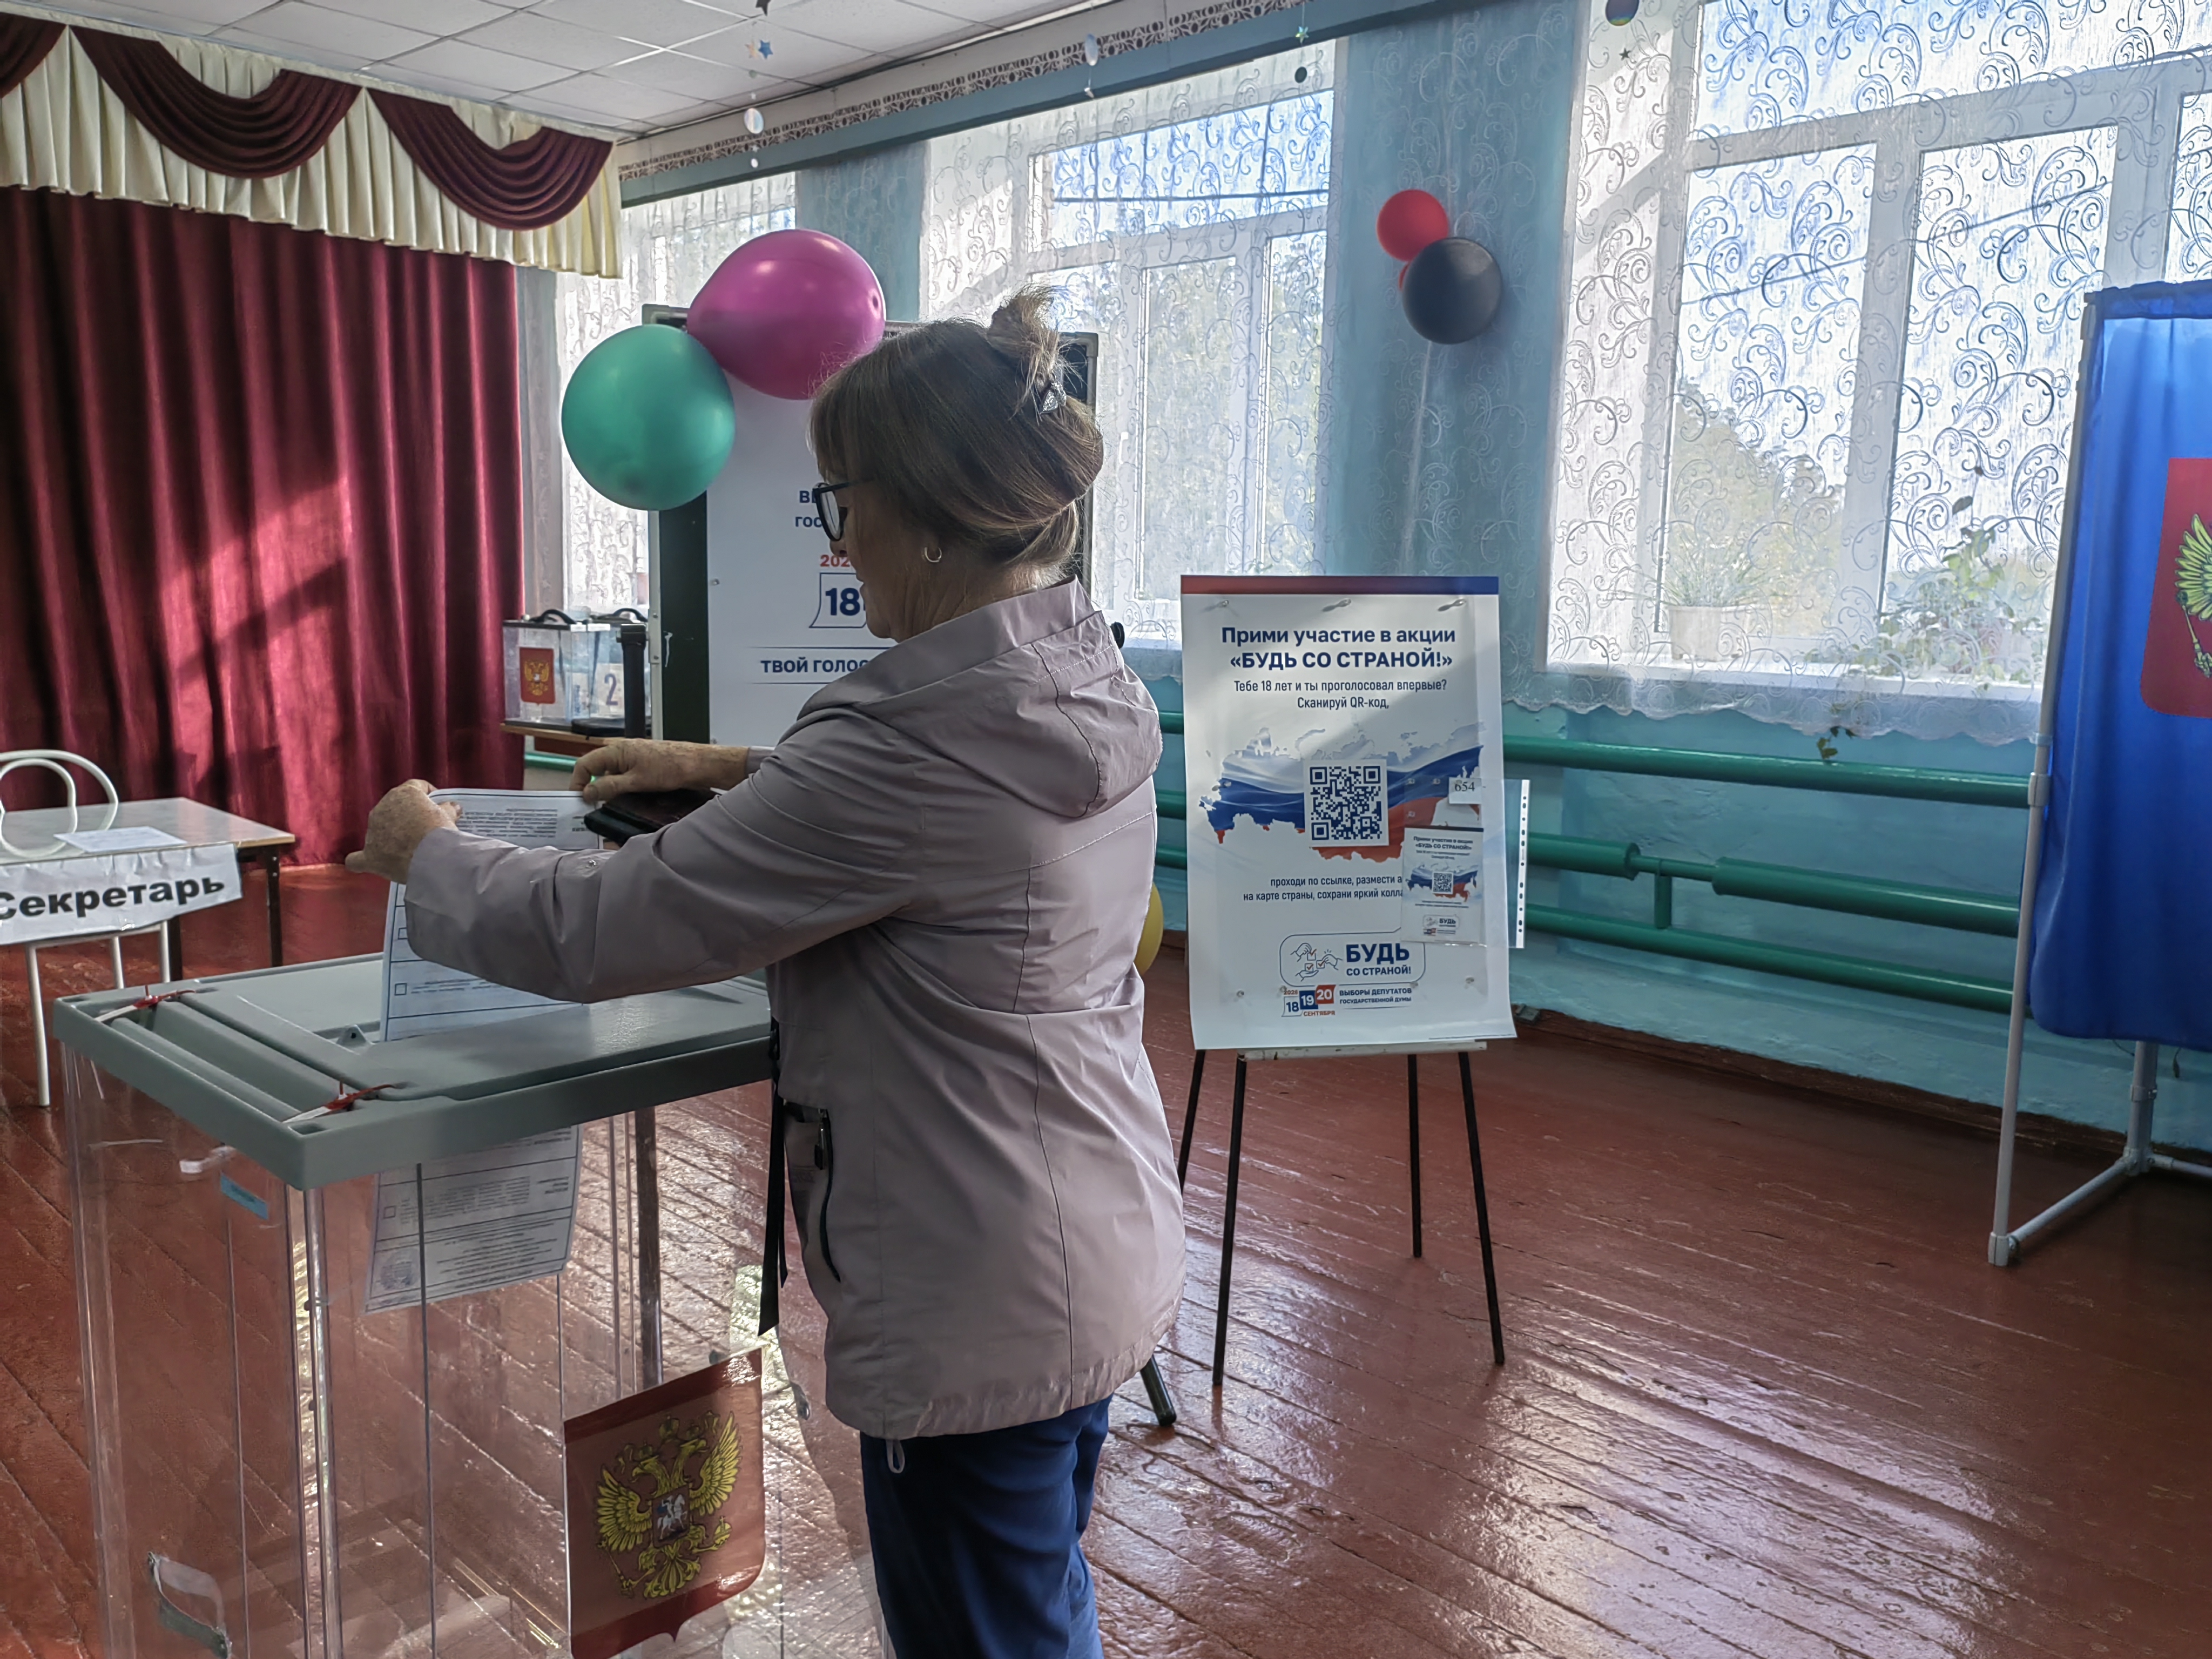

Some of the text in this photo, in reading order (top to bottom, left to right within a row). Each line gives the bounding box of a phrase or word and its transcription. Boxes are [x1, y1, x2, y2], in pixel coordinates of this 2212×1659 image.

[820, 554, 851, 567] 202
[825, 588, 861, 616] 18
[1222, 627, 1455, 647] Прими участие в акции
[760, 657, 808, 673] ТВОЙ
[1231, 647, 1453, 670] «БУДЬ СО СТРАНОЙ!»
[1234, 679, 1447, 693] Тебе 18 лет и ты проголосовал впервые?
[1297, 697, 1389, 710] Сканируй QR-код,
[1455, 781, 1475, 792] 654
[1270, 878, 1306, 888] проходи
[1321, 877, 1354, 886] ссылке,
[1356, 876, 1395, 886] размести
[1243, 893, 1253, 901] на
[1256, 892, 1279, 902] карте
[1282, 891, 1315, 901] страны,
[1317, 891, 1351, 901] сохрани
[1354, 888, 1378, 900] яркий
[1346, 943, 1410, 965] БУДЬ
[1346, 965, 1411, 976] СО СТРАНОЙ!
[1286, 989, 1332, 1012] 18 19 20
